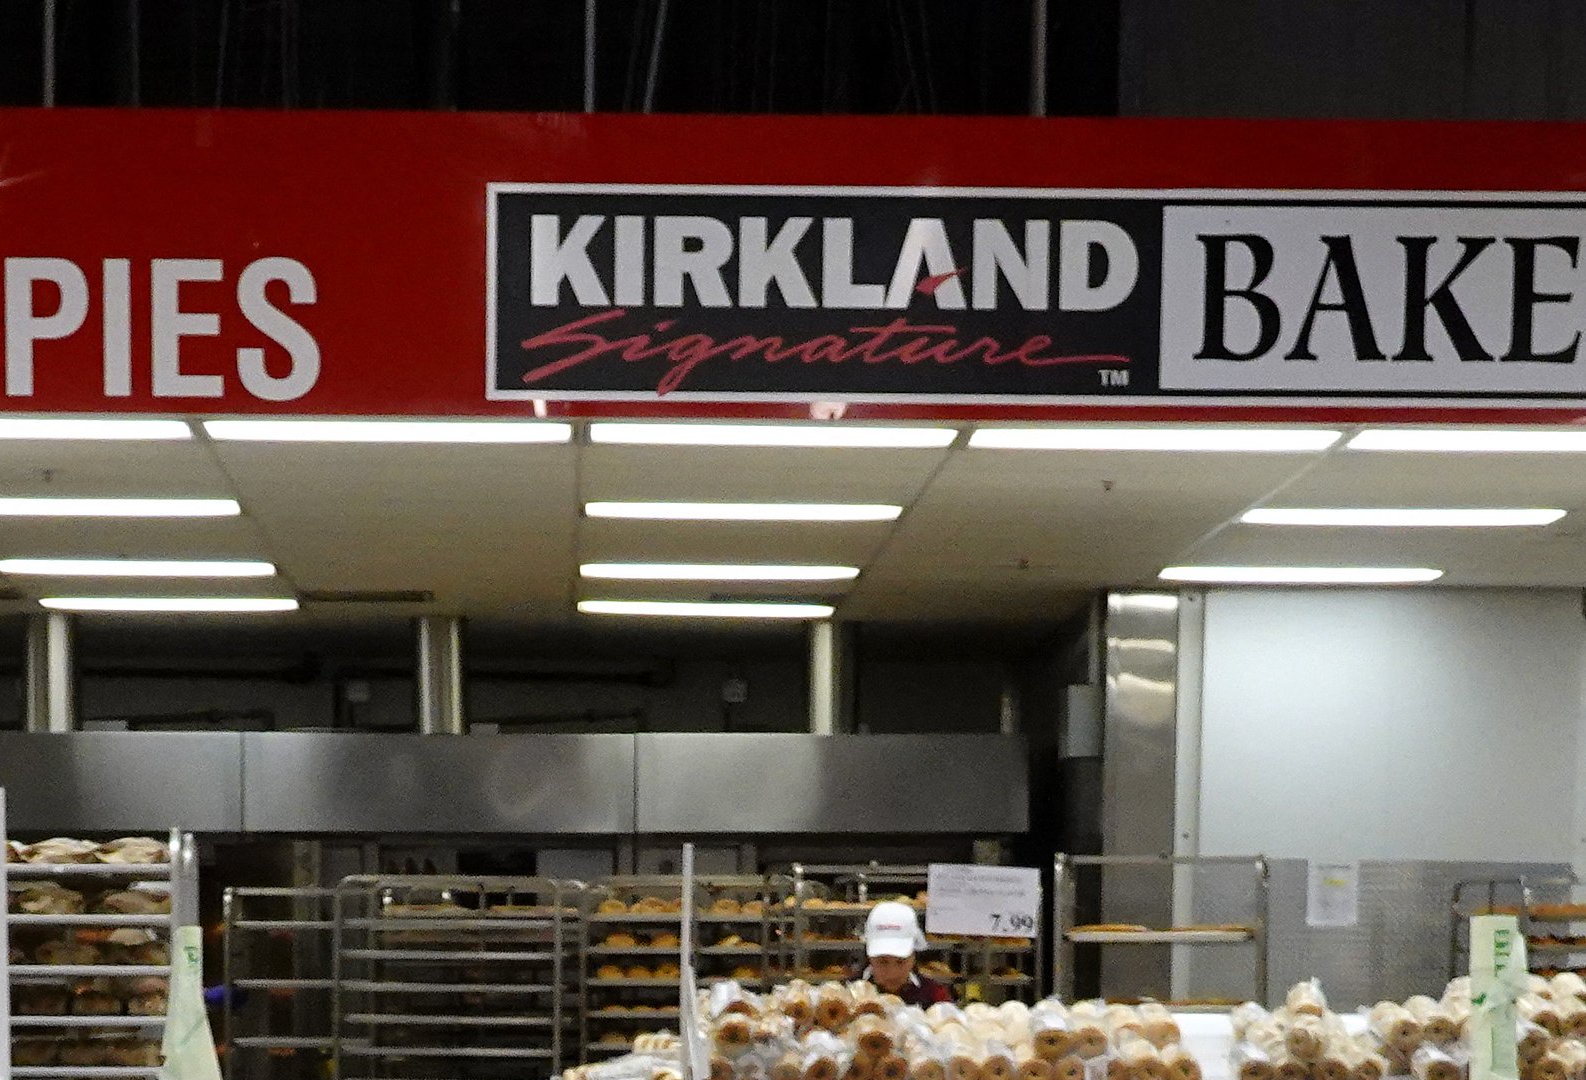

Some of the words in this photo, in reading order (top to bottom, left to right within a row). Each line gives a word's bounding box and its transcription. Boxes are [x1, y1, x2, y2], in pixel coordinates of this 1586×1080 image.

[530, 214, 1140, 311] KIRKLAND
[1192, 234, 1582, 364] BAKE
[4, 256, 322, 401] PIES
[521, 308, 1130, 396] Signature
[1098, 369, 1130, 387] TM
[990, 913, 1034, 932] 7.99
